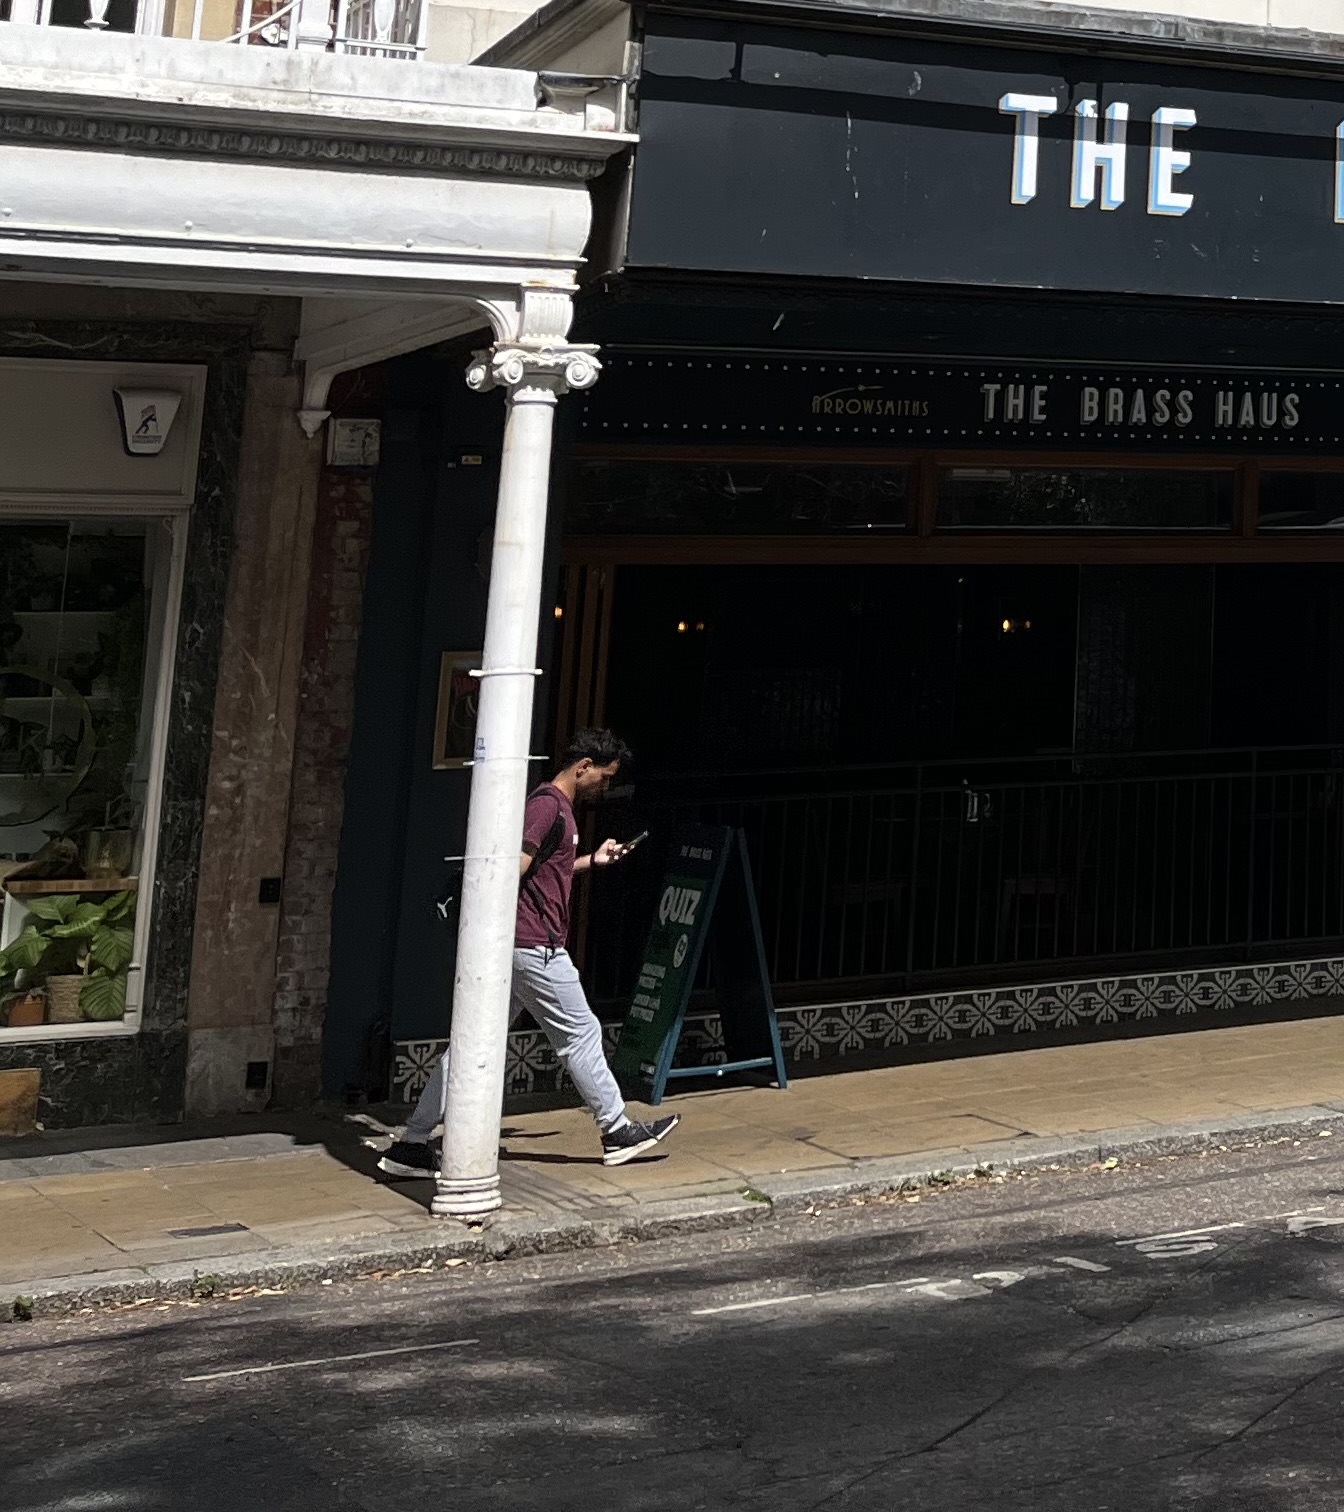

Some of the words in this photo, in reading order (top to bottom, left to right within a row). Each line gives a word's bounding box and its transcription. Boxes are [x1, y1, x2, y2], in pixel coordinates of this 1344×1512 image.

[999, 91, 1197, 217] THE
[811, 394, 929, 417] ARROWSMITHS
[979, 384, 1049, 425] THE
[1080, 387, 1194, 428] BRASS
[1214, 390, 1300, 430] HAUS
[658, 886, 702, 925] QUIZ
